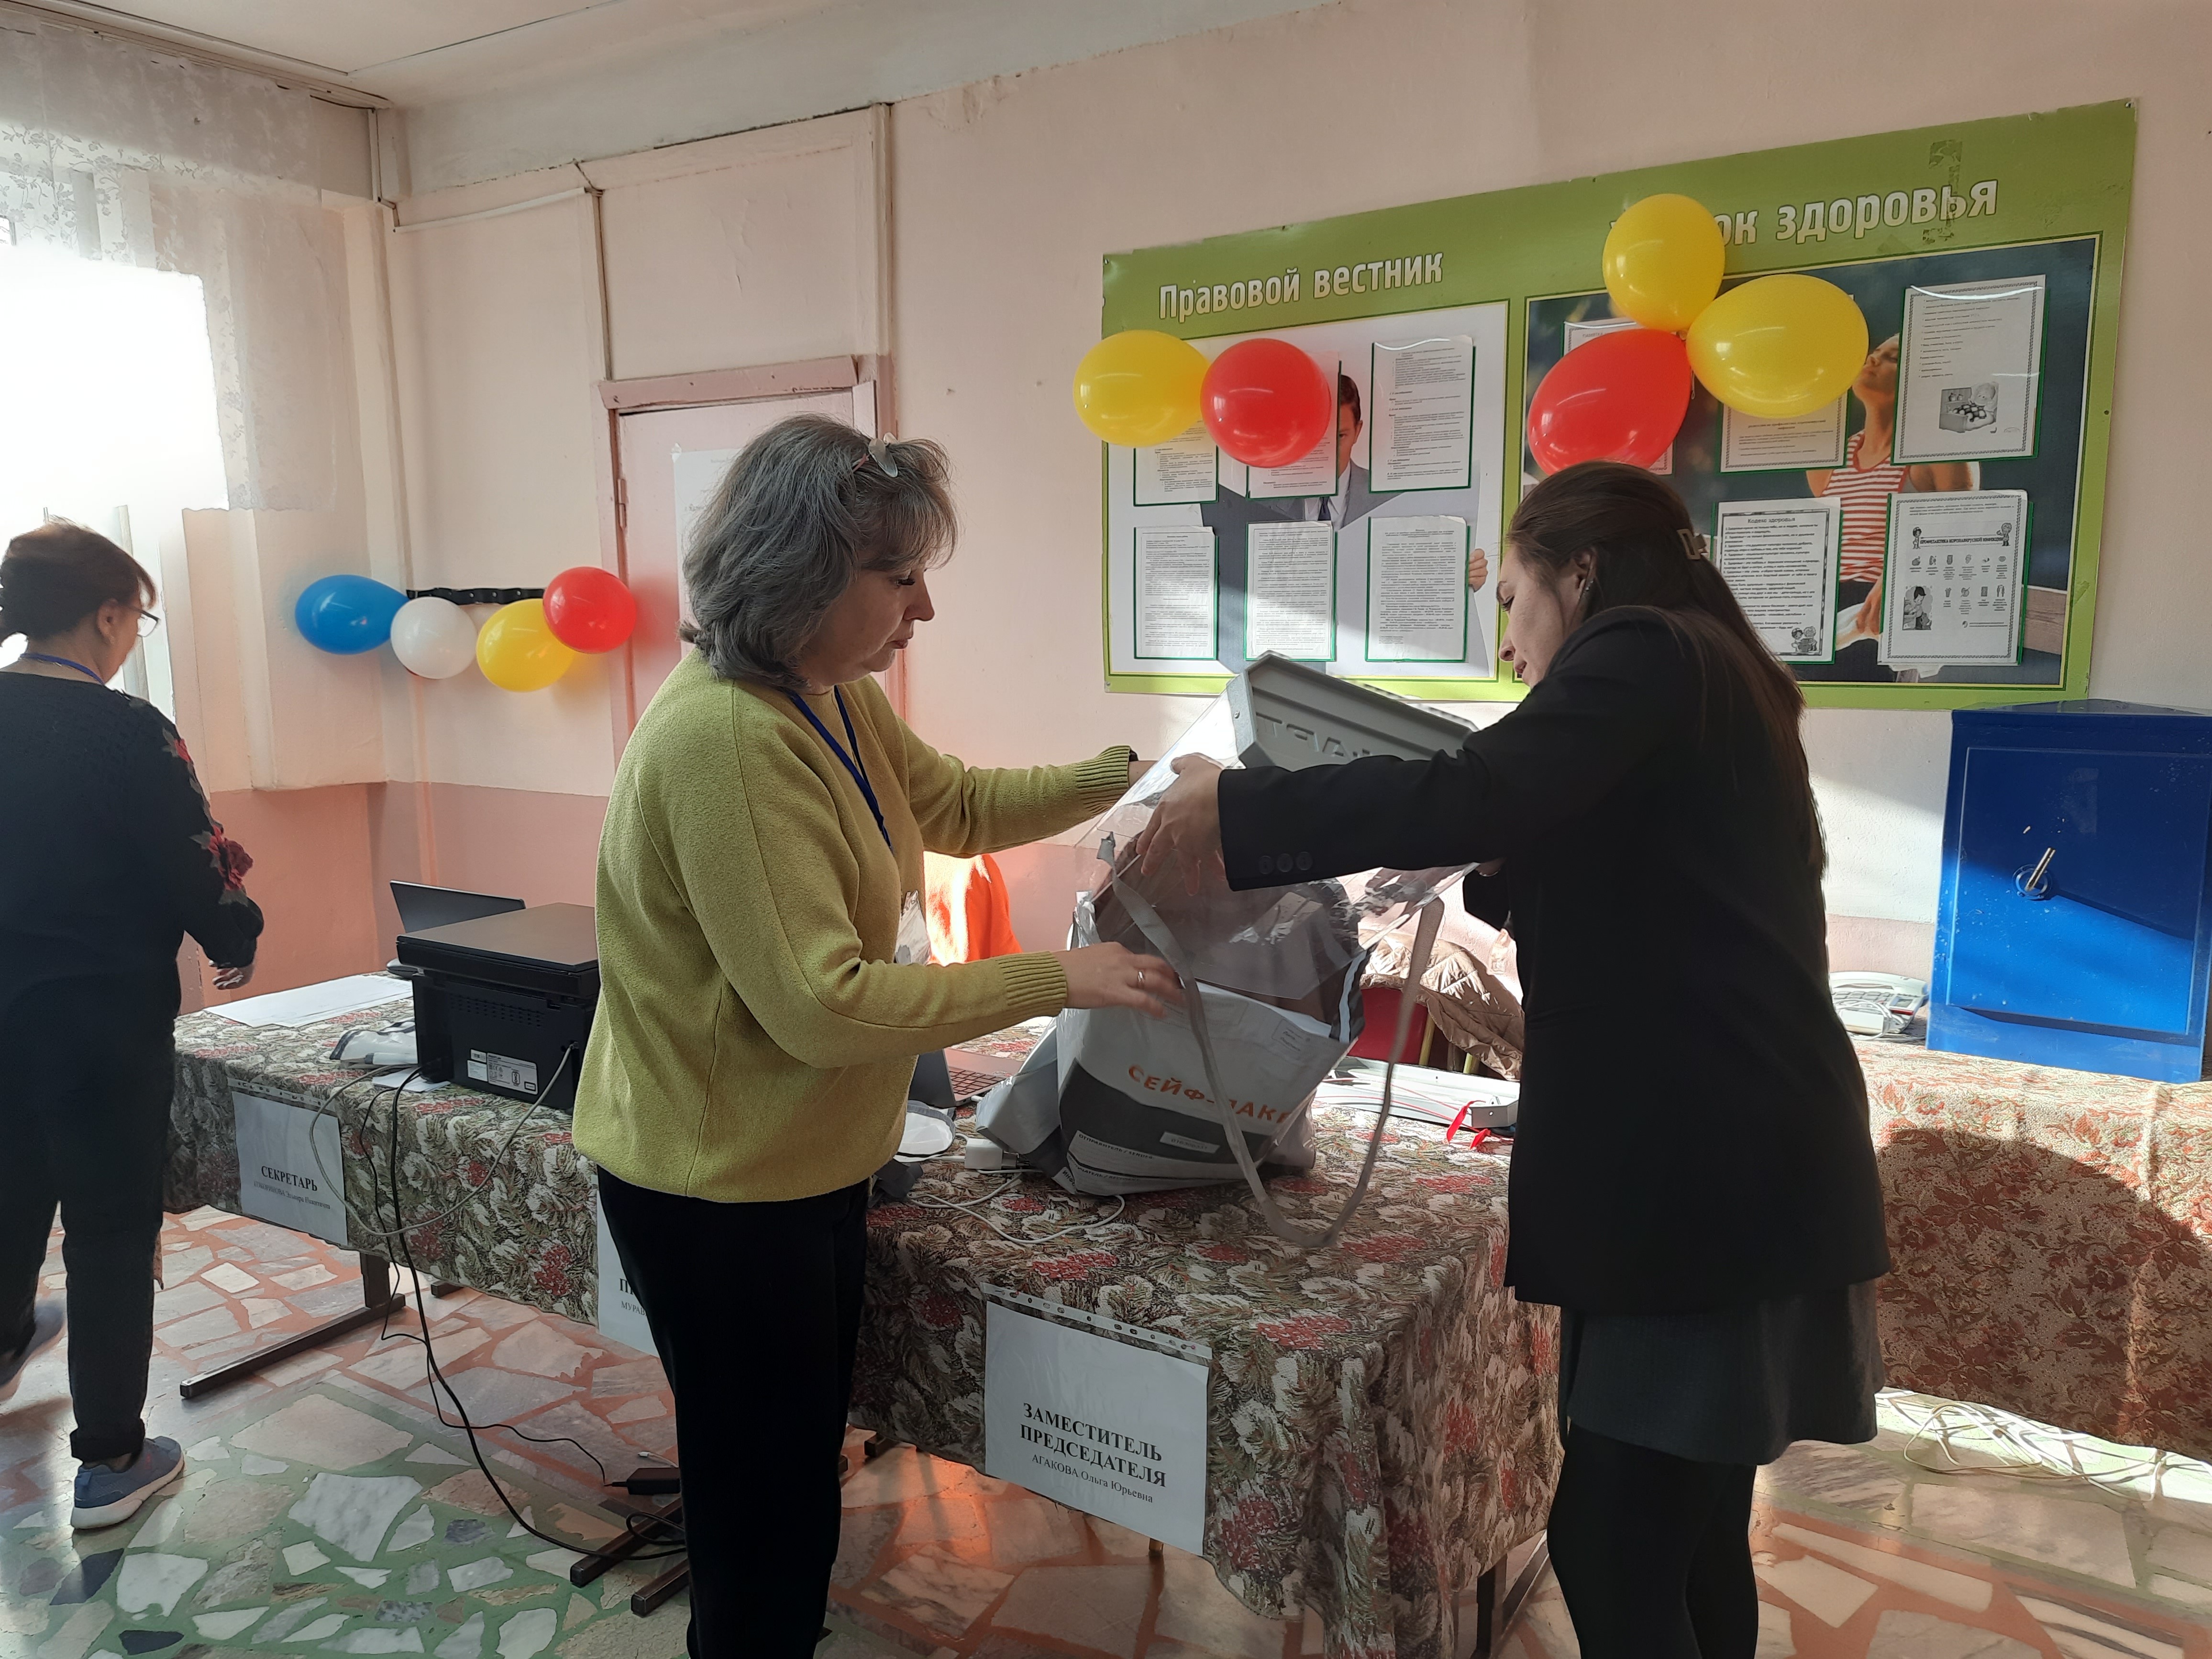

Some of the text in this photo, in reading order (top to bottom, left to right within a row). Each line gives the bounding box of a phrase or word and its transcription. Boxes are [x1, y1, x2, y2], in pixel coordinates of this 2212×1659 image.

[1776, 179, 1998, 244] здоровья
[1159, 252, 1444, 323] Правовой вестник
[1078, 1133, 1123, 1152] ОТПРАВИТЕЛЬ
[261, 1165, 318, 1192] СЕКРЕТАРЬ
[621, 1300, 647, 1317] МУРАВ
[1020, 1423, 1167, 1488] ПРЕДСЕДАТЕЛЯ
[1023, 1403, 1162, 1461] ЗАМЕСТИТЕЛЬ
[1031, 1454, 1153, 1504] АГАКОВА Ольга Юрьевна
